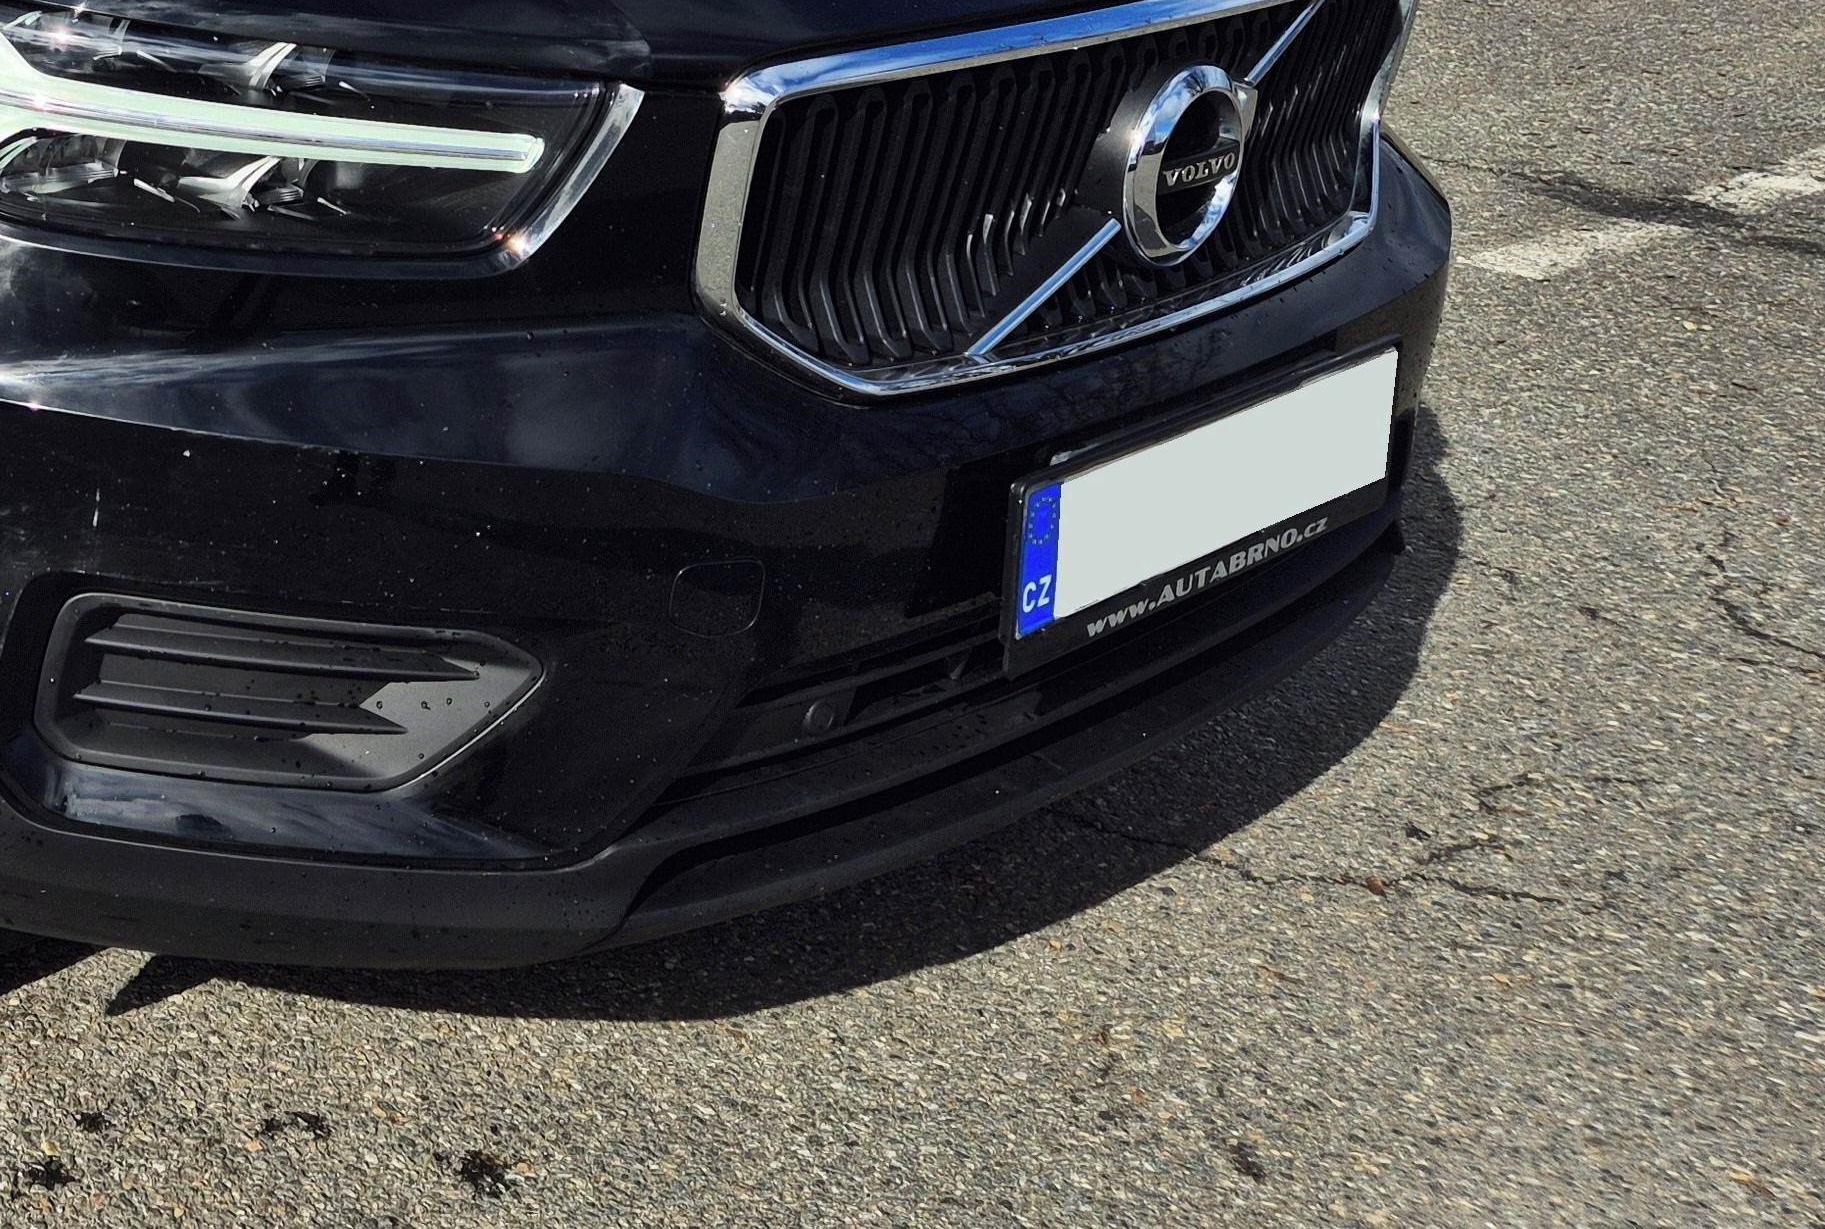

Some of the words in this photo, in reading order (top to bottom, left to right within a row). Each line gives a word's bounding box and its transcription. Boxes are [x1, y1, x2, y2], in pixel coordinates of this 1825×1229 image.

[1162, 152, 1236, 187] VOLVO
[1022, 573, 1053, 614] CZ
[1086, 516, 1329, 638] www.AUTABRNO.cz
